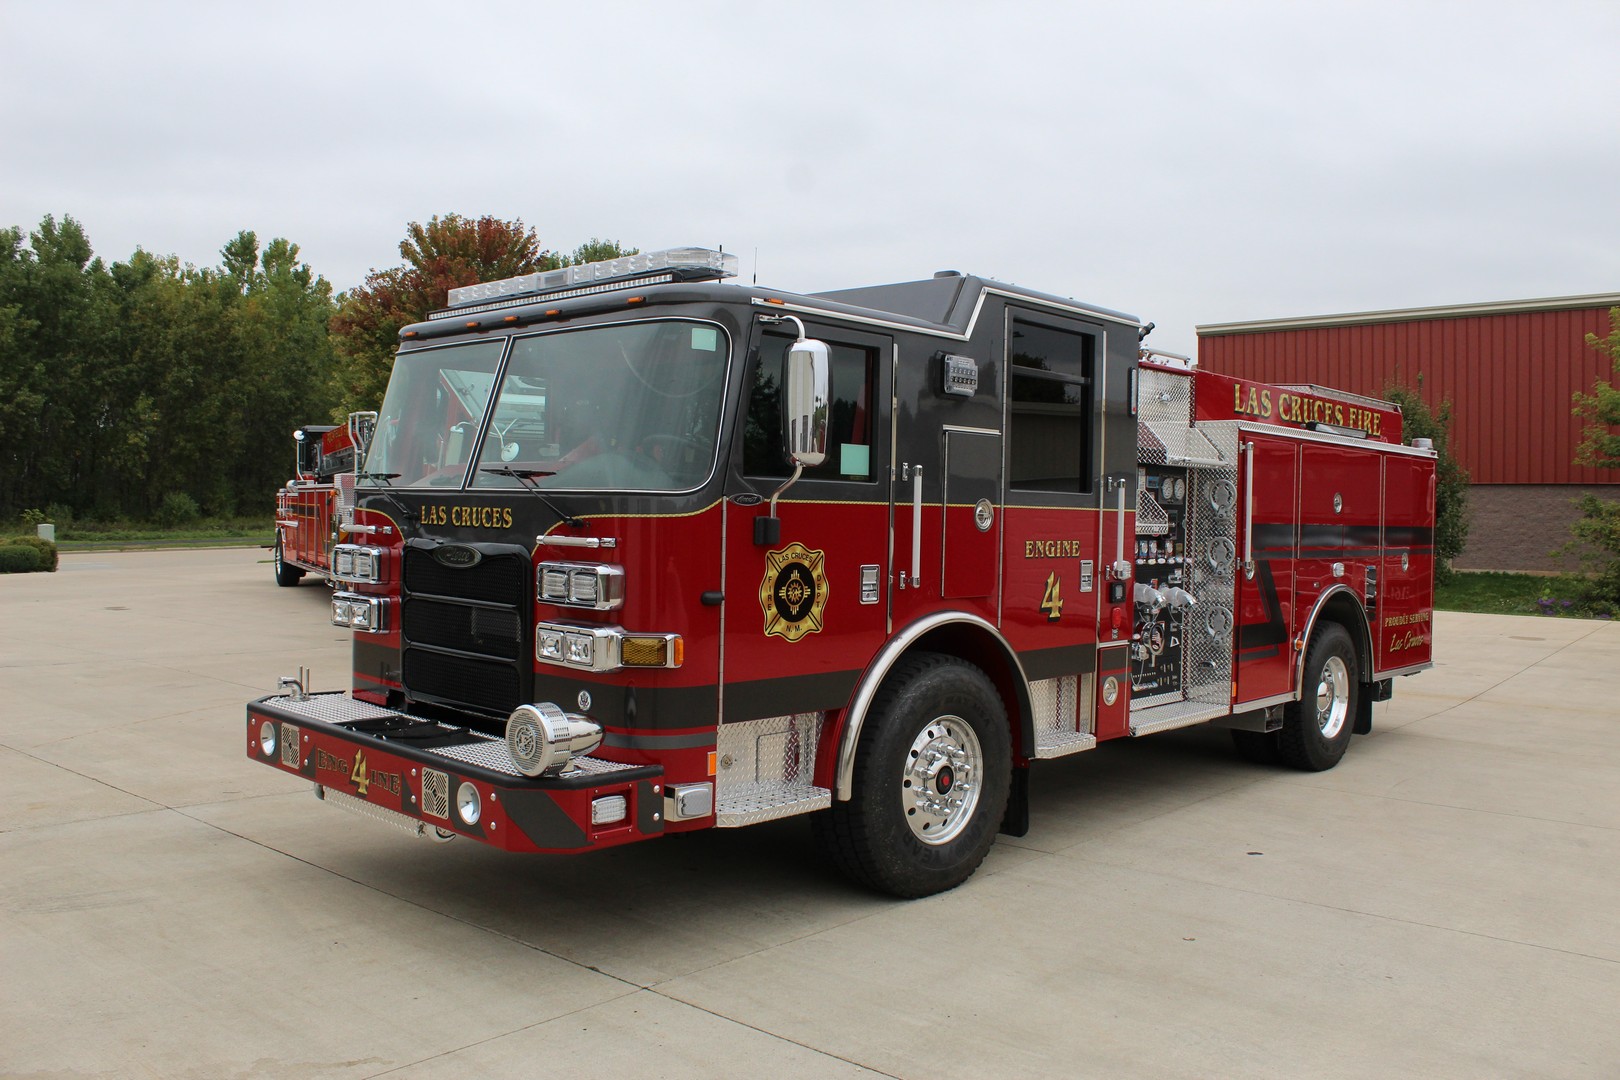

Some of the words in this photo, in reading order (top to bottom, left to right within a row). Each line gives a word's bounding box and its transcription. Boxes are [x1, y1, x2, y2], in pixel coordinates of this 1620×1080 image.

[1234, 383, 1272, 418] LAS
[1278, 393, 1344, 426] CRUCES
[1349, 407, 1381, 436] FIRE
[421, 505, 447, 526] LAS
[451, 506, 513, 529] CRUCES
[778, 553, 790, 564] LAS
[791, 552, 813, 563] CRUCES
[1025, 540, 1080, 558] ENGINE
[1040, 570, 1064, 620] 4
[317, 747, 348, 774] ENG
[349, 747, 370, 798] 4
